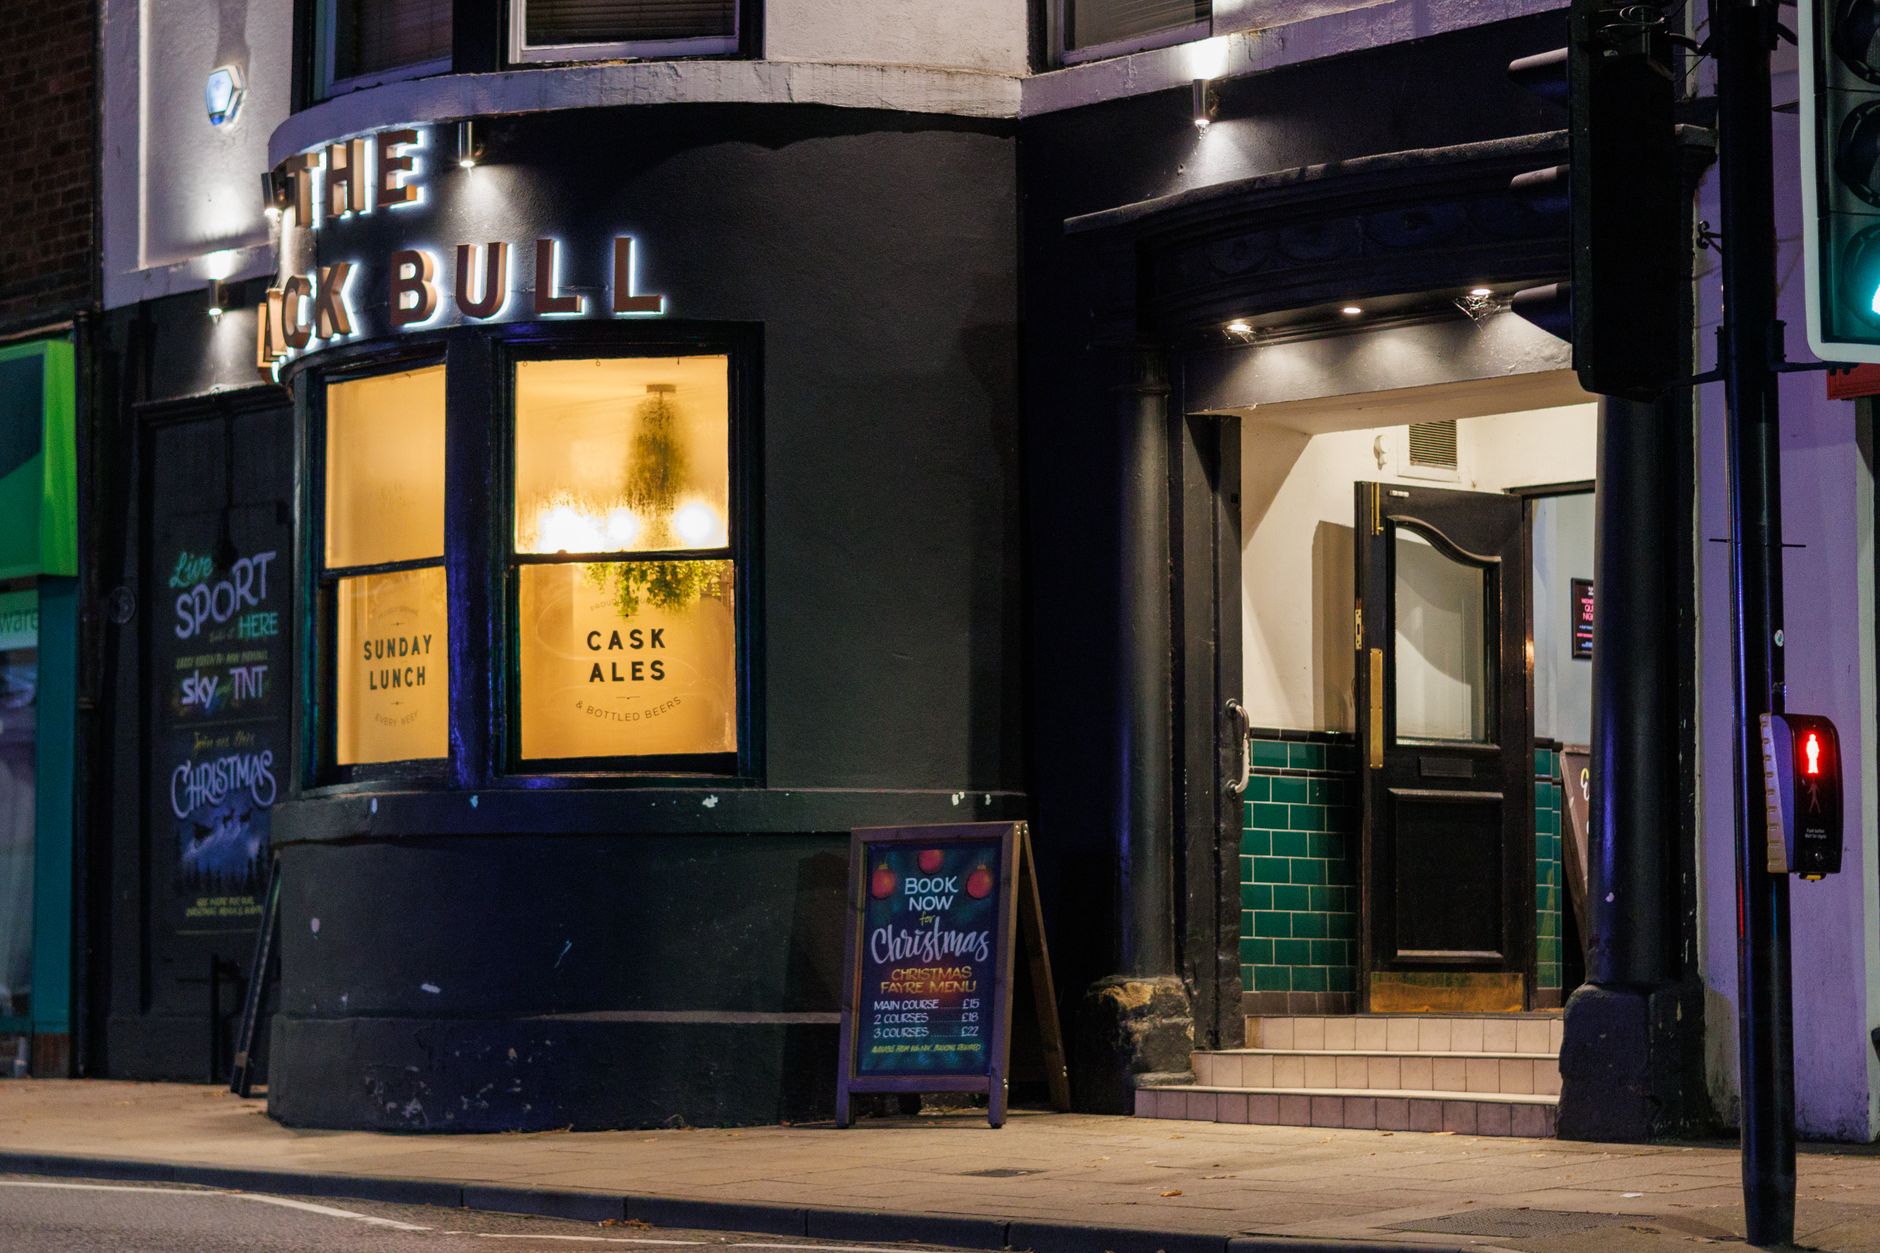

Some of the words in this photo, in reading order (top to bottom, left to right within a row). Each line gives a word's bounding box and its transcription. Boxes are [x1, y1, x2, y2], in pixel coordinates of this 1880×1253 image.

[281, 129, 423, 228] THE
[391, 237, 664, 327] BULL
[169, 552, 213, 588] Live
[175, 552, 277, 639] SPORT
[238, 612, 279, 639] HERE
[364, 634, 432, 661] SUNDAY
[587, 628, 666, 651] CASK
[369, 666, 426, 690] LUNCH
[589, 660, 666, 683] ALES
[182, 669, 219, 709] sky
[230, 666, 268, 700] TNT
[575, 700, 583, 709] &
[586, 706, 641, 722] BOTTLED
[645, 697, 682, 719] BEERS
[171, 750, 277, 819] CHRISTMAS
[905, 876, 959, 895] BOOK
[909, 895, 954, 911] NOW
[919, 911, 935, 926] for
[871, 916, 989, 964] Christmas
[891, 965, 972, 981] CHRISTMAS
[880, 981, 923, 994] FAYRE
[929, 980, 977, 993] MENU
[874, 1000, 899, 1010] MAIN
[901, 999, 939, 1010] COURSE
[962, 999, 979, 1009] £15
[874, 1014, 881, 1025] 2
[884, 1013, 929, 1024] COURSES
[961, 1012, 979, 1023] £18
[874, 1028, 881, 1038] 3
[883, 1027, 929, 1038] COURSES
[961, 1026, 979, 1037] £22
